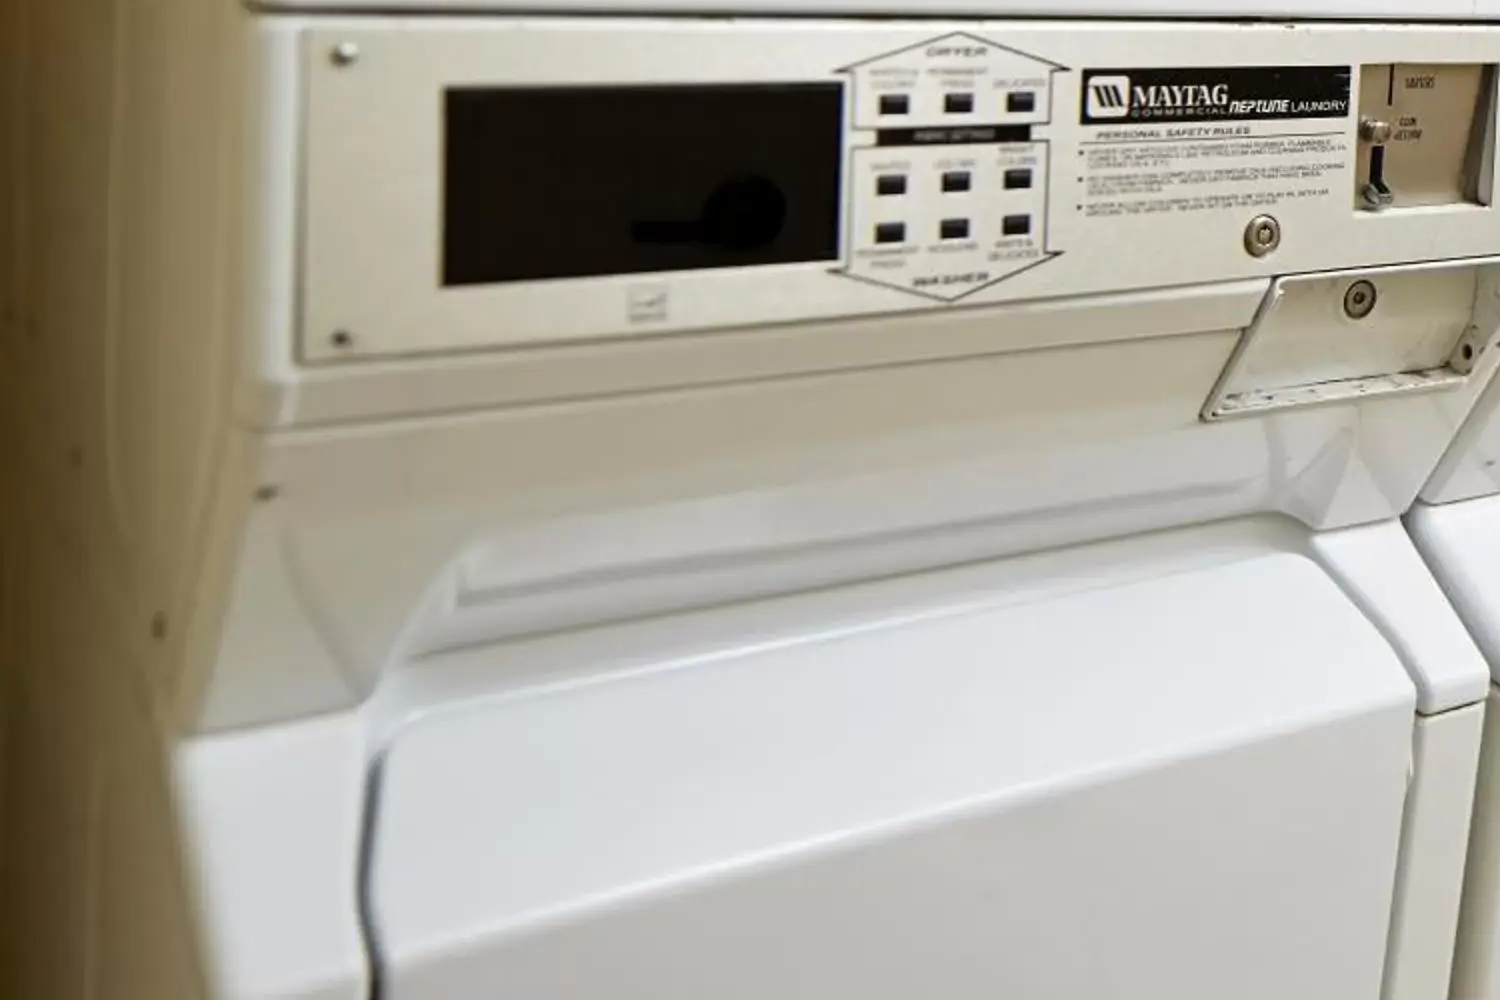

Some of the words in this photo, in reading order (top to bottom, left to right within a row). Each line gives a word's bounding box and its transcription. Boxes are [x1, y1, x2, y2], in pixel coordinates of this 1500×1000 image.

[1131, 84, 1229, 108] MAYTAG
[1131, 106, 1227, 118] COMMERCIAL
[1229, 99, 1290, 114] NEPTUNE
[1291, 99, 1347, 113] LAUNDRY
[1096, 129, 1161, 139] PERSONAL
[1166, 128, 1211, 137] SAFETY
[1213, 126, 1251, 135] RULES
